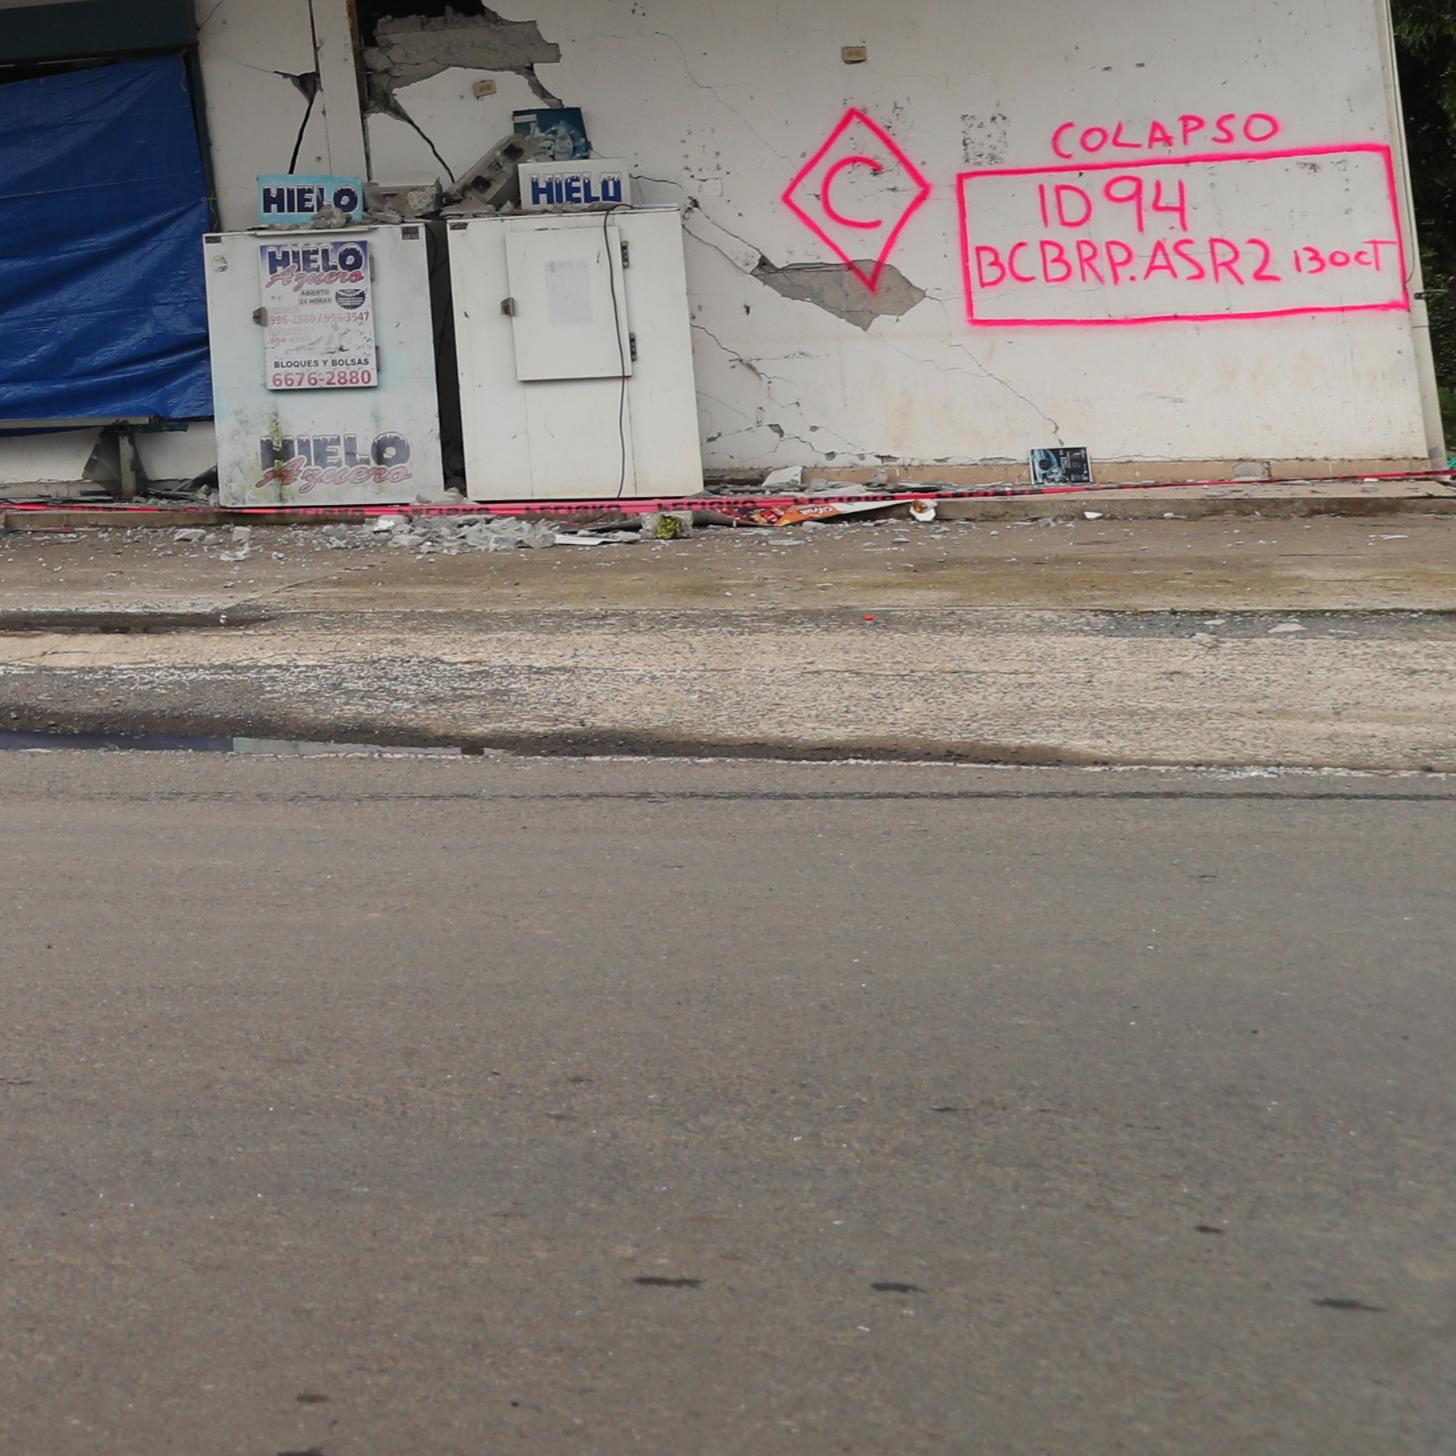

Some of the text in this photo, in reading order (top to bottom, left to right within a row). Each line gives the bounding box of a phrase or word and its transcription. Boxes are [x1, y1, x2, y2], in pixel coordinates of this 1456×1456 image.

[1051, 112, 1281, 160] COLAPSO
[262, 185, 359, 214] HIELO
[530, 171, 623, 206] HIELO
[820, 154, 885, 231] C
[267, 243, 364, 275] HIELO
[265, 264, 365, 292] Azuero
[271, 369, 372, 388] 6676-2880
[273, 357, 370, 369] BLOQUES Y BOLSAS
[259, 431, 411, 471] HIELO
[256, 455, 413, 494] Azuero
